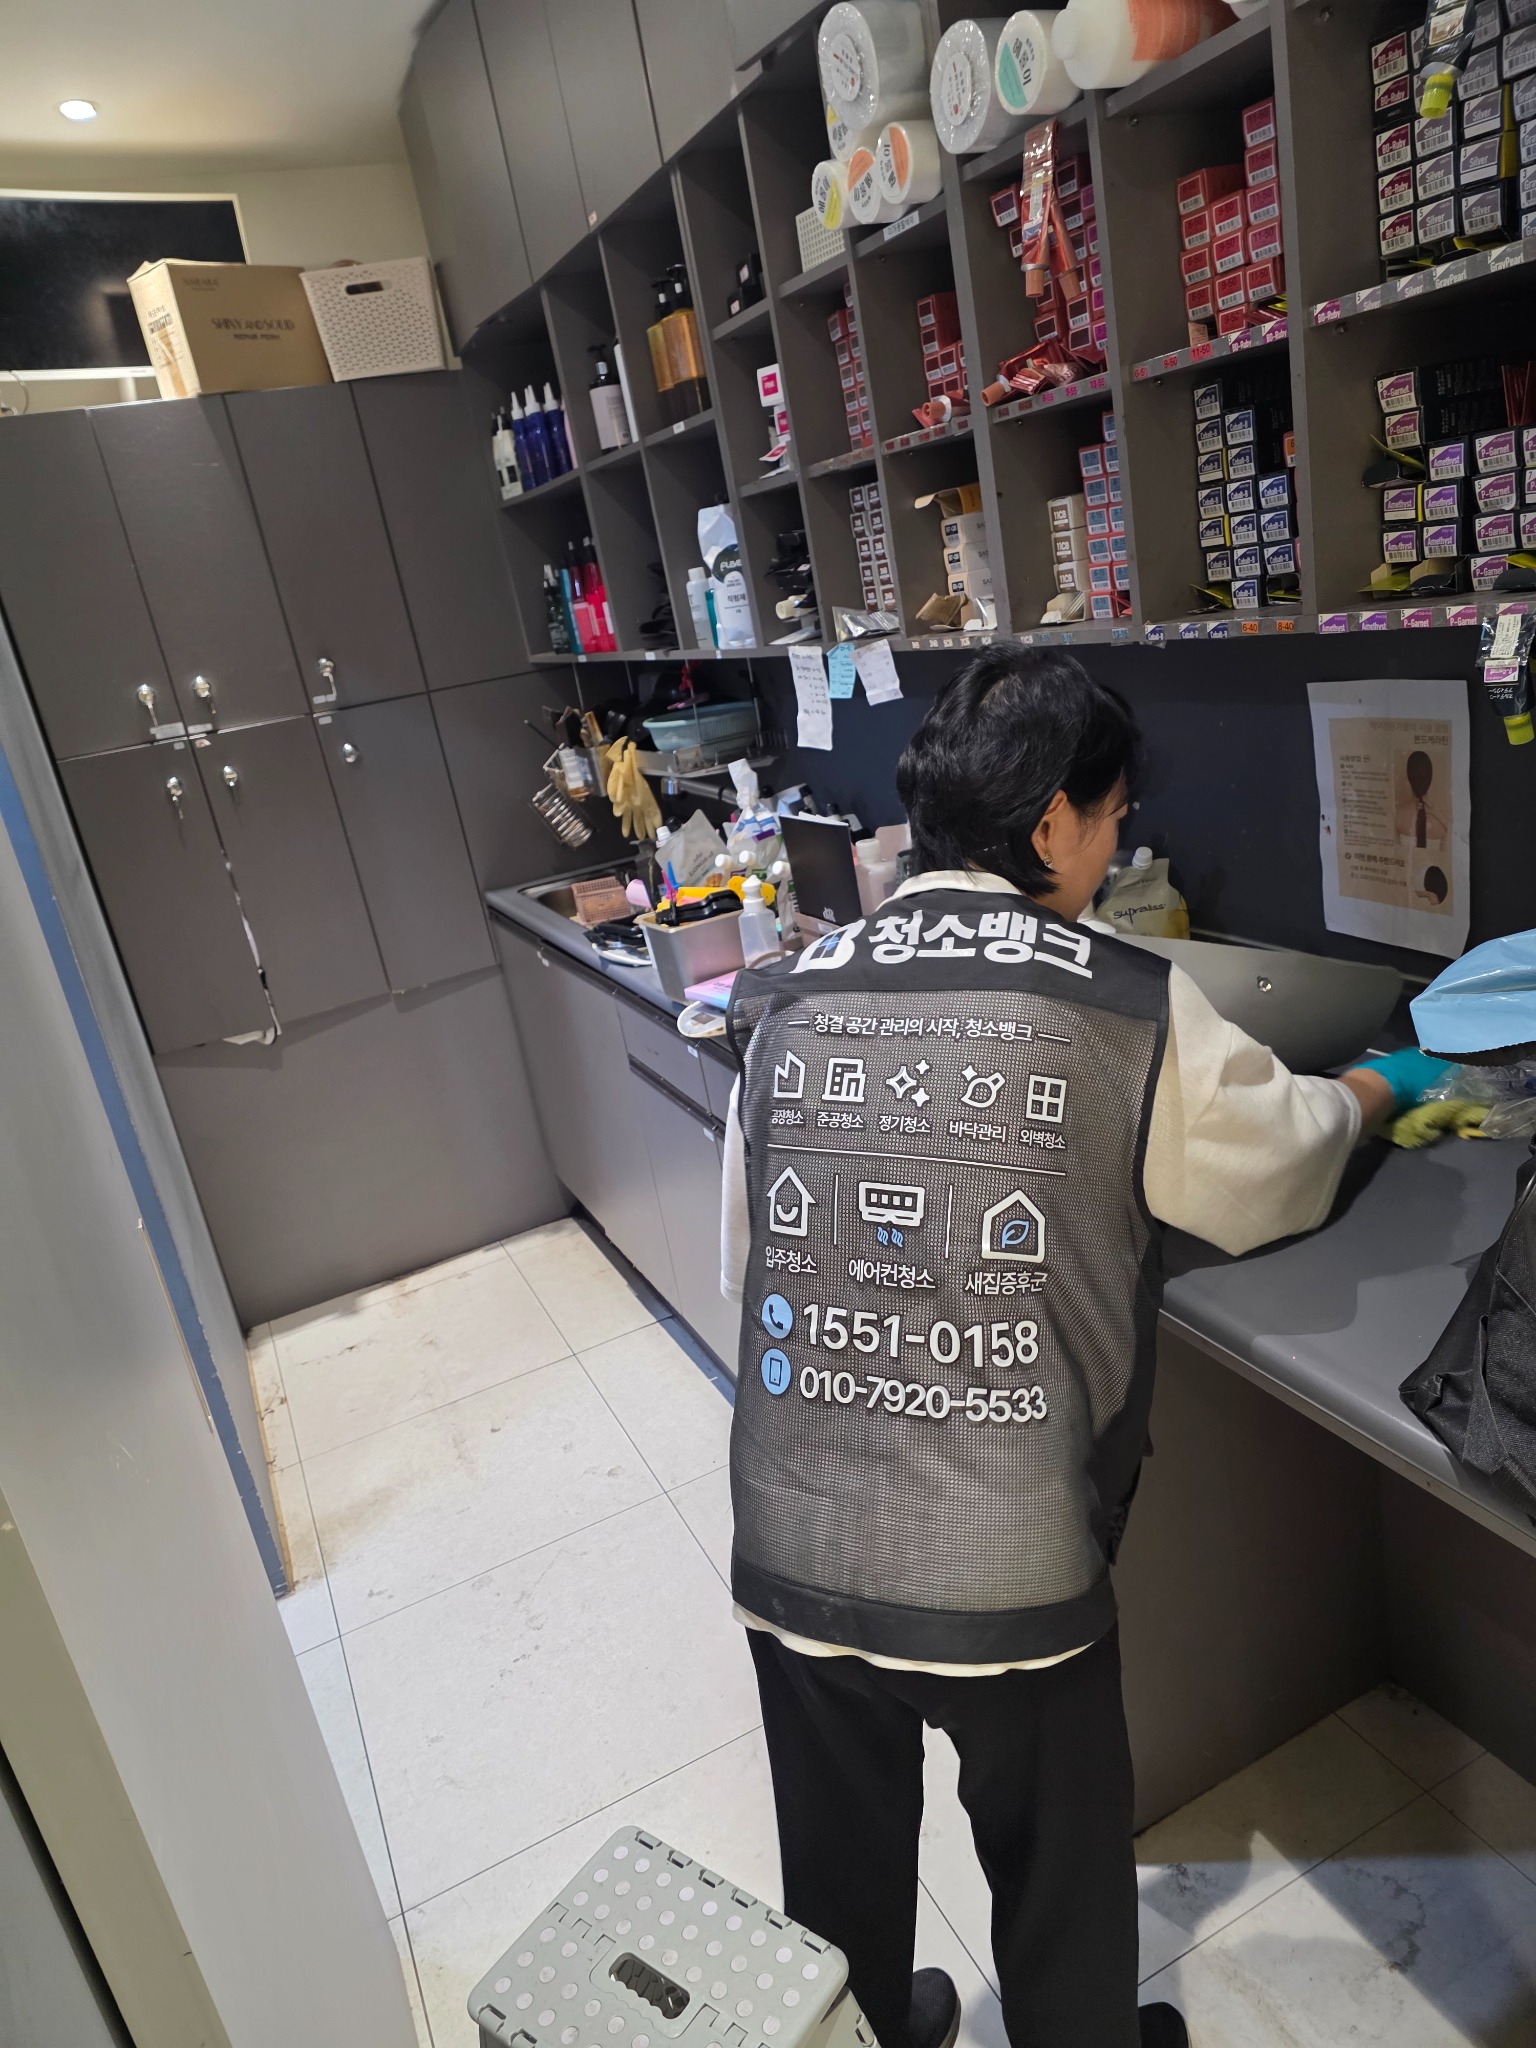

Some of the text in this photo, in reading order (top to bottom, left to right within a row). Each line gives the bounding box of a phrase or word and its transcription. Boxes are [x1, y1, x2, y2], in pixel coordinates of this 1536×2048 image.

[1472, 107, 1491, 121] Silver
[1424, 124, 1443, 139] Silver
[1469, 153, 1488, 167] Silver
[1425, 168, 1444, 182] Silver
[1472, 204, 1491, 217] Silver
[1426, 212, 1445, 227] Silver
[1404, 285, 1423, 298] Silver
[1363, 300, 1381, 311] Silver
[1192, 344, 1210, 358] 11-50
[1163, 356, 1178, 369] 9-50
[1383, 385, 1410, 399] P-Garnet
[1481, 444, 1510, 458] P-Garnet
[1481, 487, 1511, 499] P-Garnet
[1481, 527, 1509, 538] P-Garnet
[1476, 566, 1504, 577] P-Garnet
[1242, 623, 1258, 632] 6-40
[1278, 622, 1294, 631] 8-40
[1403, 619, 1429, 628] P-Garnet
[1450, 616, 1477, 626] P-Garnet
[868, 909, 1093, 978] 청소뱅크
[813, 1013, 1033, 1042] 청결 공간 관리의 시작, 청소뱅크
[771, 1109, 1066, 1150] 공장청소 준공청소 정기청소 바닥관리 외벽청소
[765, 1245, 1048, 1296] 입주청소 에어컨청소 새집증후군
[802, 1303, 1040, 1369] 1551-0158
[800, 1365, 1048, 1423] 010-7920-5533
